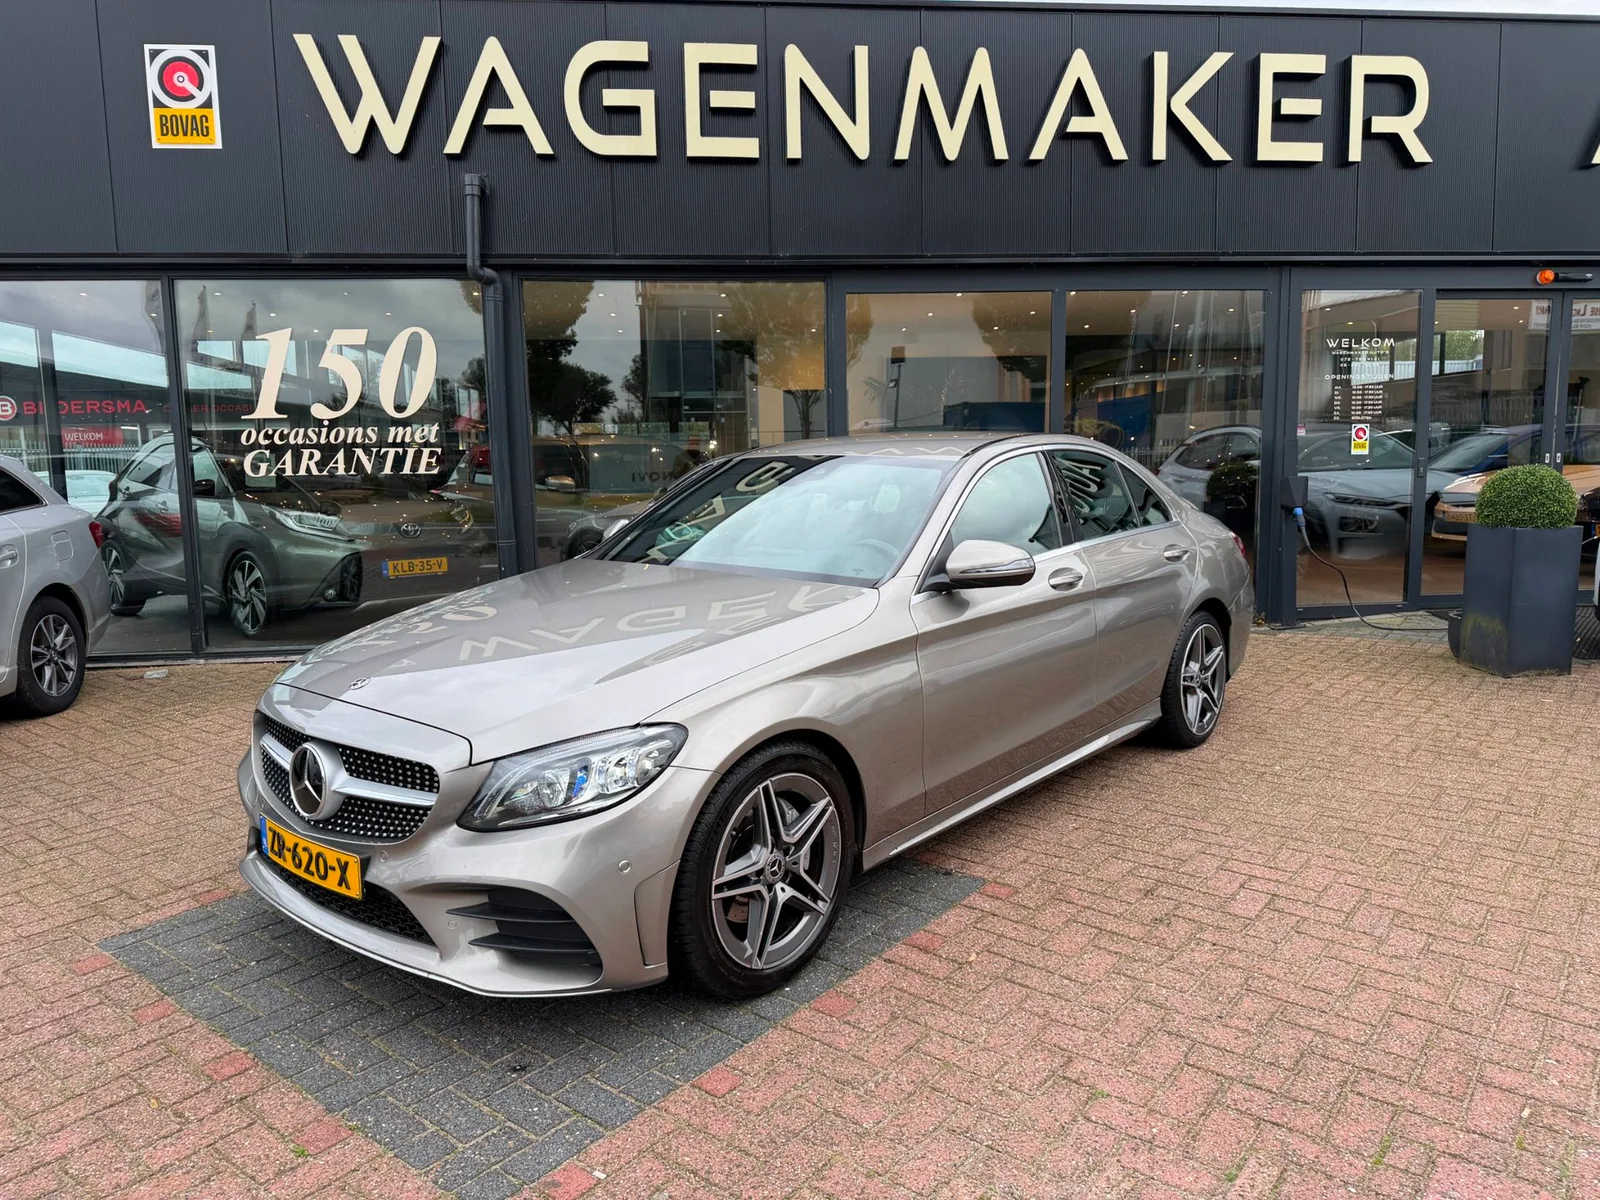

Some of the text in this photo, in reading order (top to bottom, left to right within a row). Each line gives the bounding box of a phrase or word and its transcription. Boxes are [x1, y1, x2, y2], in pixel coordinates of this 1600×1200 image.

[293, 34, 1433, 163] WAGENMAKER
[159, 114, 210, 137] BOVAG
[1326, 338, 1395, 348] WELKOM
[241, 326, 438, 420] 150
[22, 400, 147, 415] BIDERSMA
[64, 431, 104, 442] WELKOM
[240, 420, 440, 446] occasions met
[243, 447, 442, 478] GARANTIE
[392, 559, 443, 573] KLB-35-V
[267, 819, 352, 891] ZR-620-X
